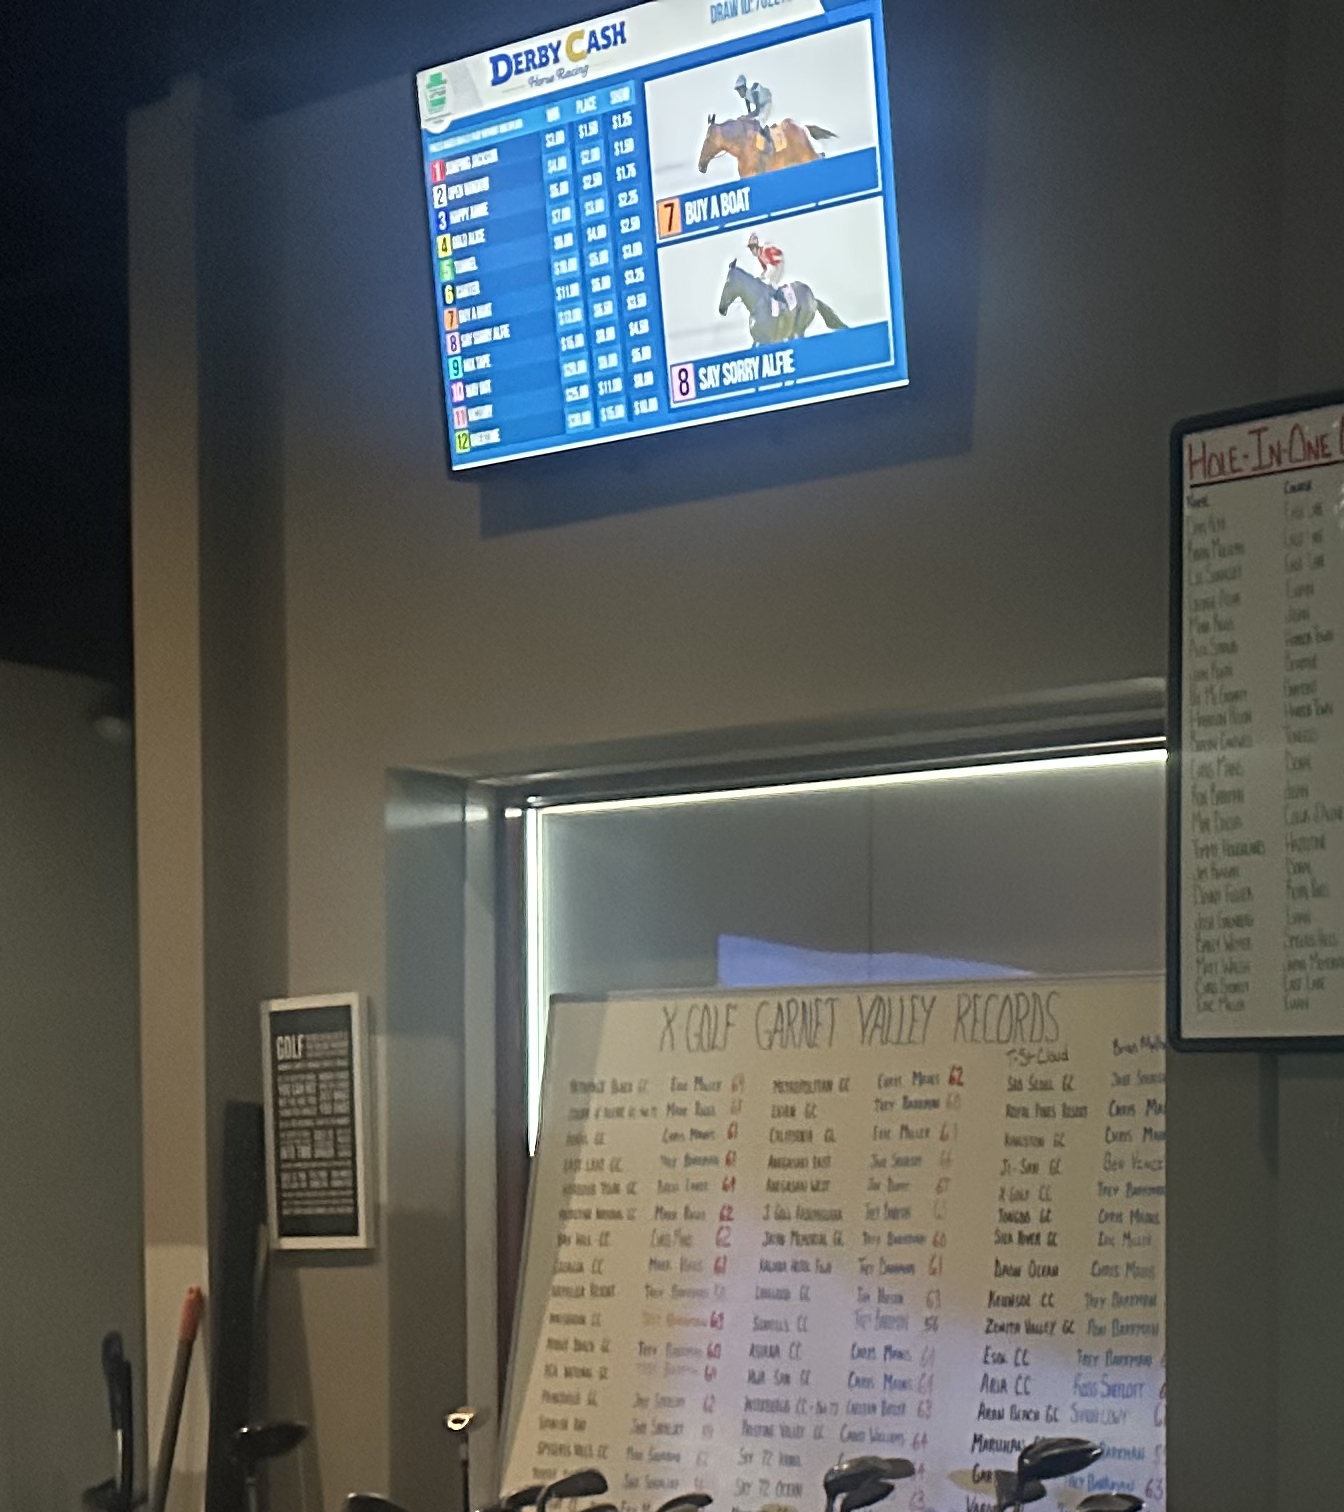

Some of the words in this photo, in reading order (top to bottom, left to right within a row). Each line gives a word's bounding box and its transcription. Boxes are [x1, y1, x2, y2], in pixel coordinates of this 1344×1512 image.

[490, 40, 562, 86] DERBY
[565, 21, 627, 62] CASH
[557, 63, 590, 82] Racing
[433, 160, 442, 181] 1
[436, 187, 444, 206] 2
[664, 202, 674, 232] 7
[684, 197, 709, 225] BUY
[710, 194, 720, 219] A
[720, 186, 751, 217] BOAT
[438, 213, 447, 231] 3
[441, 239, 449, 254] 4
[444, 284, 454, 305] 6
[447, 310, 455, 327] 7
[449, 334, 458, 353] 8
[452, 358, 460, 377] 9
[678, 367, 690, 396] 8
[698, 364, 721, 390] SAY
[721, 356, 760, 386] SORRY
[761, 349, 796, 378] ALFIE
[451, 383, 464, 402] 10
[455, 409, 467, 426] 11
[457, 433, 469, 450] 12
[659, 1005, 678, 1052] X
[685, 1002, 738, 1053] GOLF
[754, 996, 841, 1051] GARNET
[857, 993, 937, 1046] VALLEY
[953, 990, 1061, 1044] RECORDS
